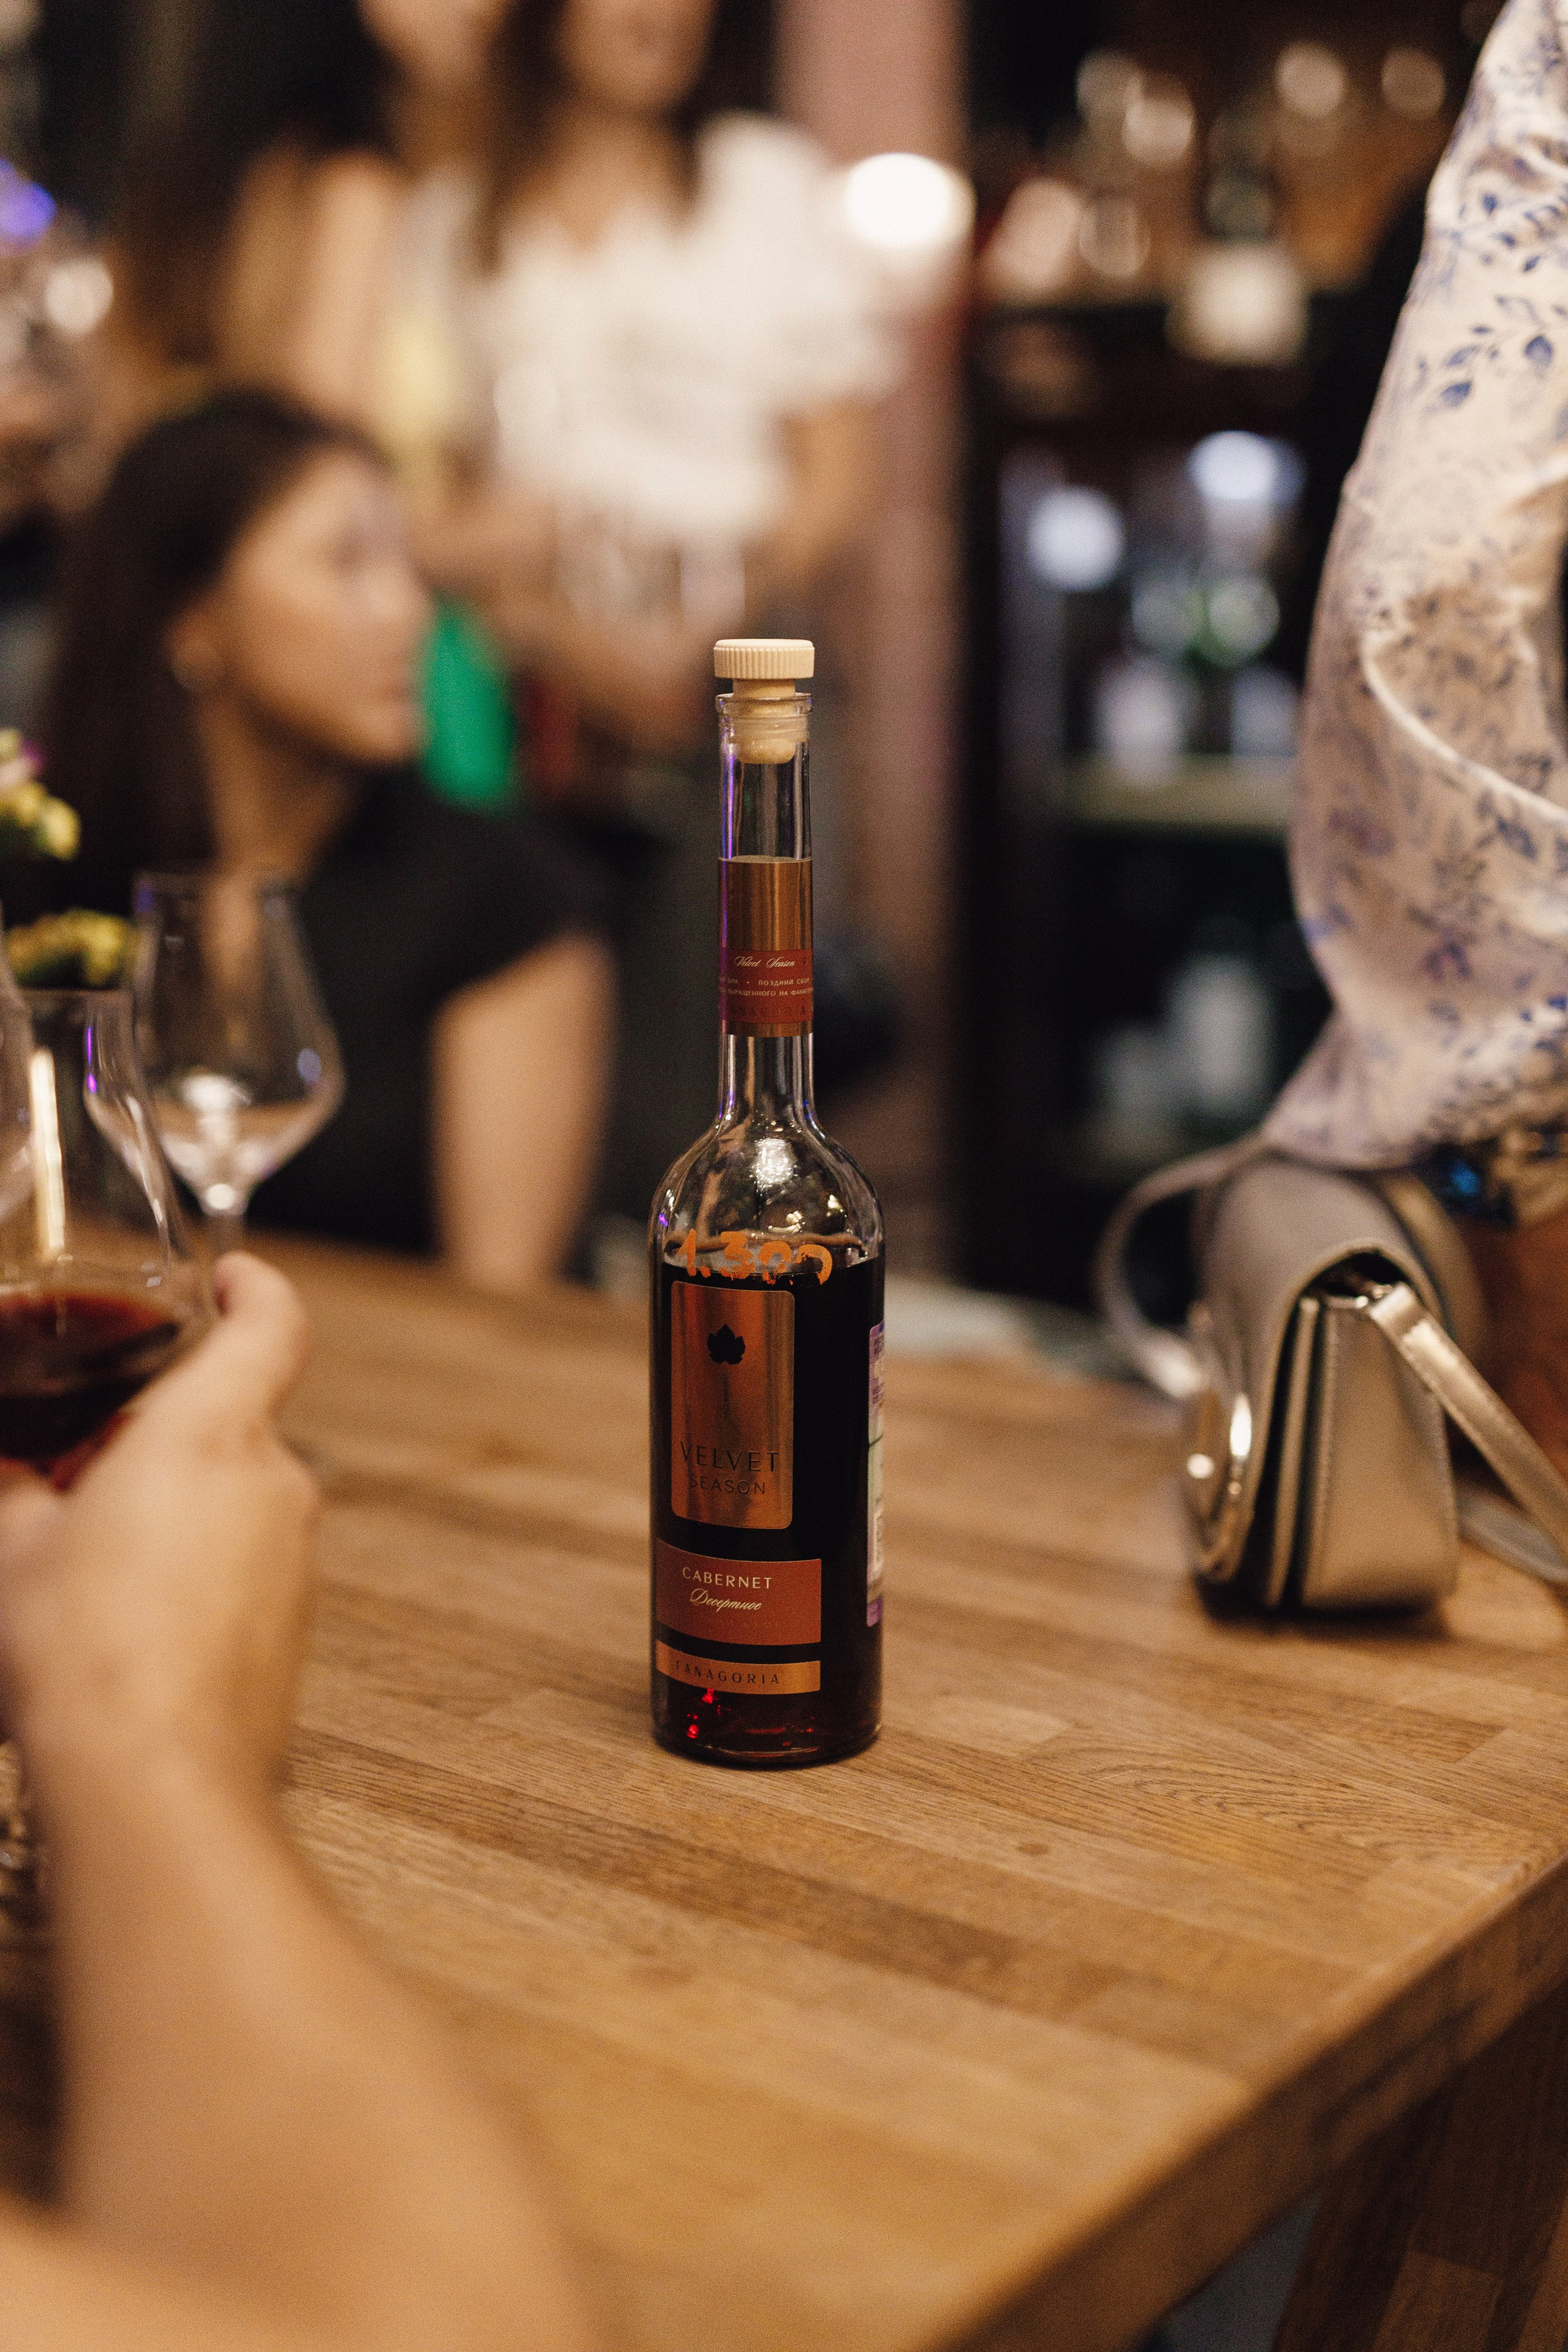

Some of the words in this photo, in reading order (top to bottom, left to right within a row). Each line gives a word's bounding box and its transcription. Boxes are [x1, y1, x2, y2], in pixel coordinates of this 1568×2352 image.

[734, 956, 762, 967] Velvet
[766, 956, 796, 968] Season
[680, 1441, 779, 1472] VELVET
[690, 1473, 766, 1494] SEASON
[682, 1566, 772, 1589] CABERNET
[675, 1659, 780, 1685] FANAGORIA
